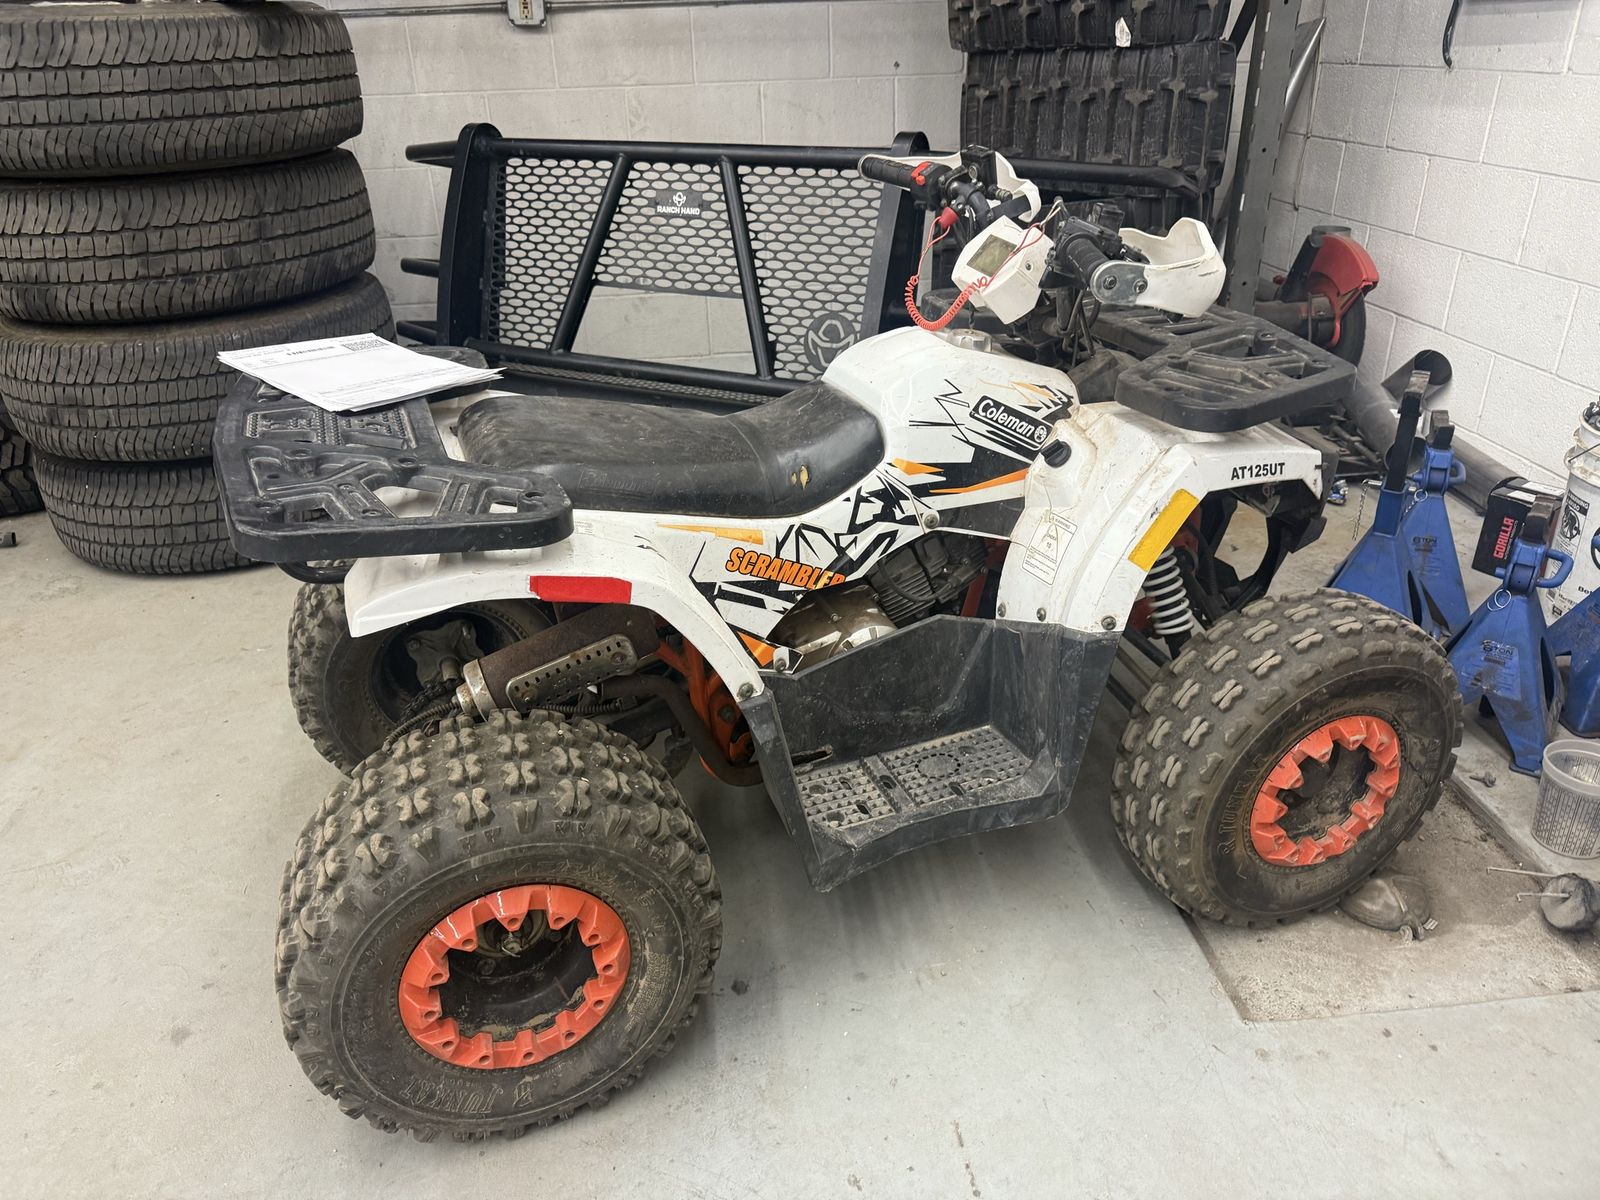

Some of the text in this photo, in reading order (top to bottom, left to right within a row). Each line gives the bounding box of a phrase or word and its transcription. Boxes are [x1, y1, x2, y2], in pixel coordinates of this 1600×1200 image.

[656, 205, 700, 215] RANCH HAND
[978, 399, 1035, 438] Coleman
[1231, 462, 1286, 480] AT125UT
[1493, 517, 1515, 559] GORILLA
